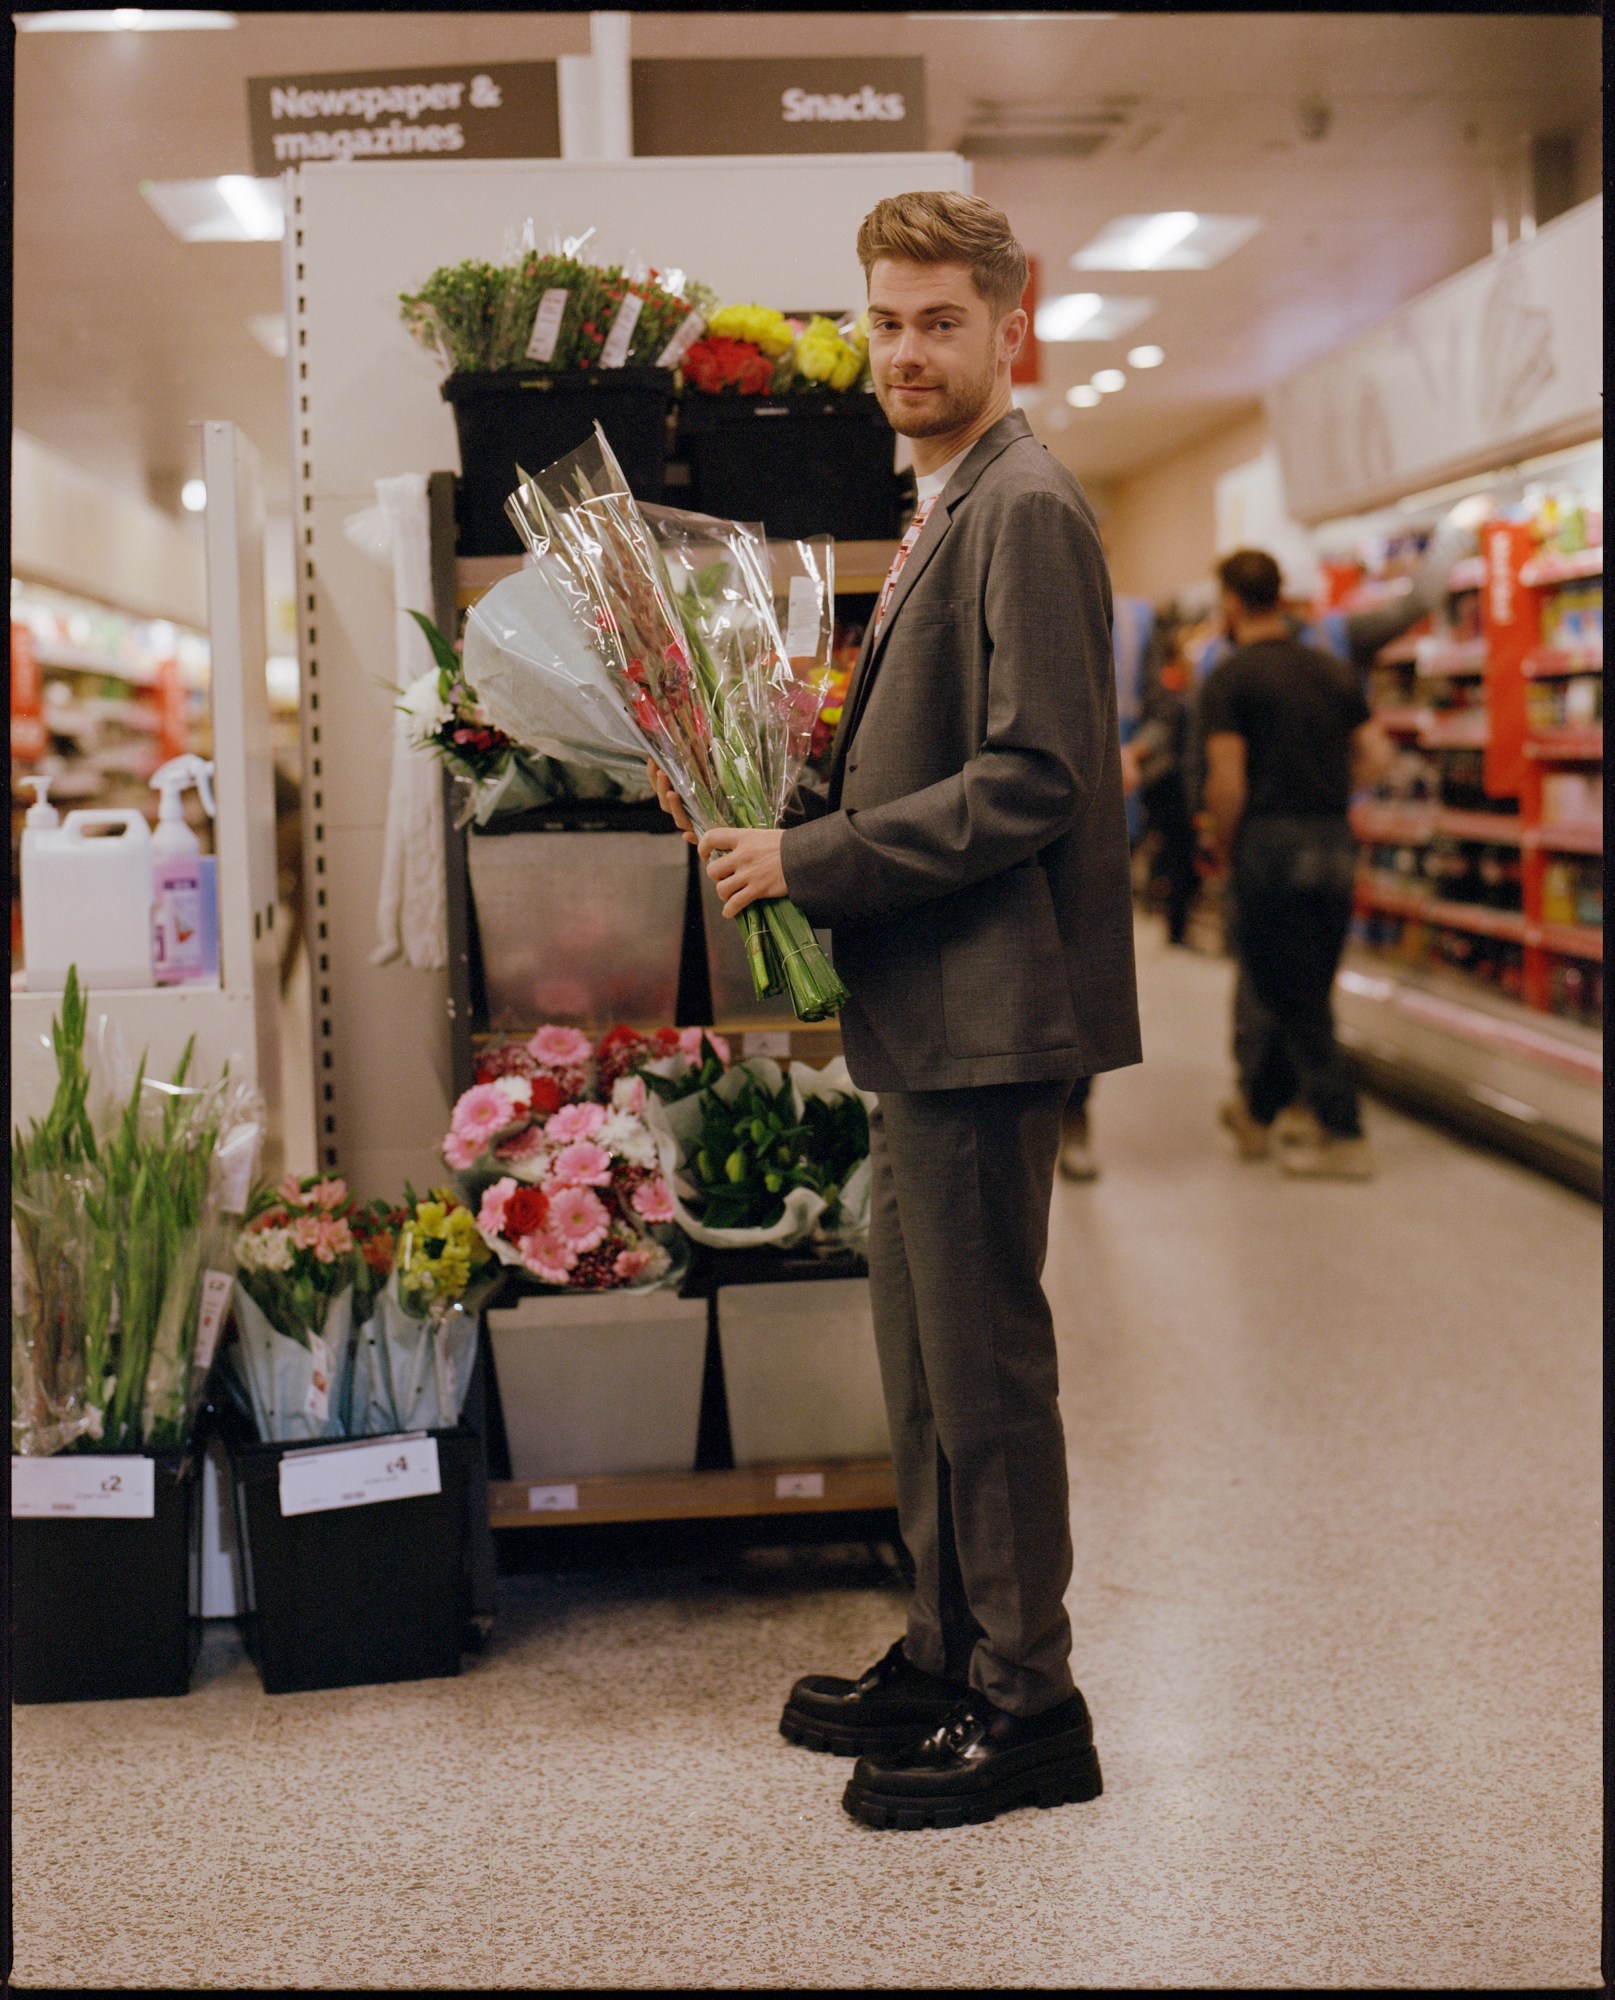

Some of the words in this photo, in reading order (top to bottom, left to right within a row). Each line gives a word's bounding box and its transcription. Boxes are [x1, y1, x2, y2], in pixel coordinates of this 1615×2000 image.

[270, 83, 465, 122] Newspaper
[469, 74, 502, 108] &
[781, 86, 905, 121] Snacks
[272, 118, 465, 162] magazines
[386, 1455, 408, 1473] £4
[101, 1475, 123, 1492] £2
